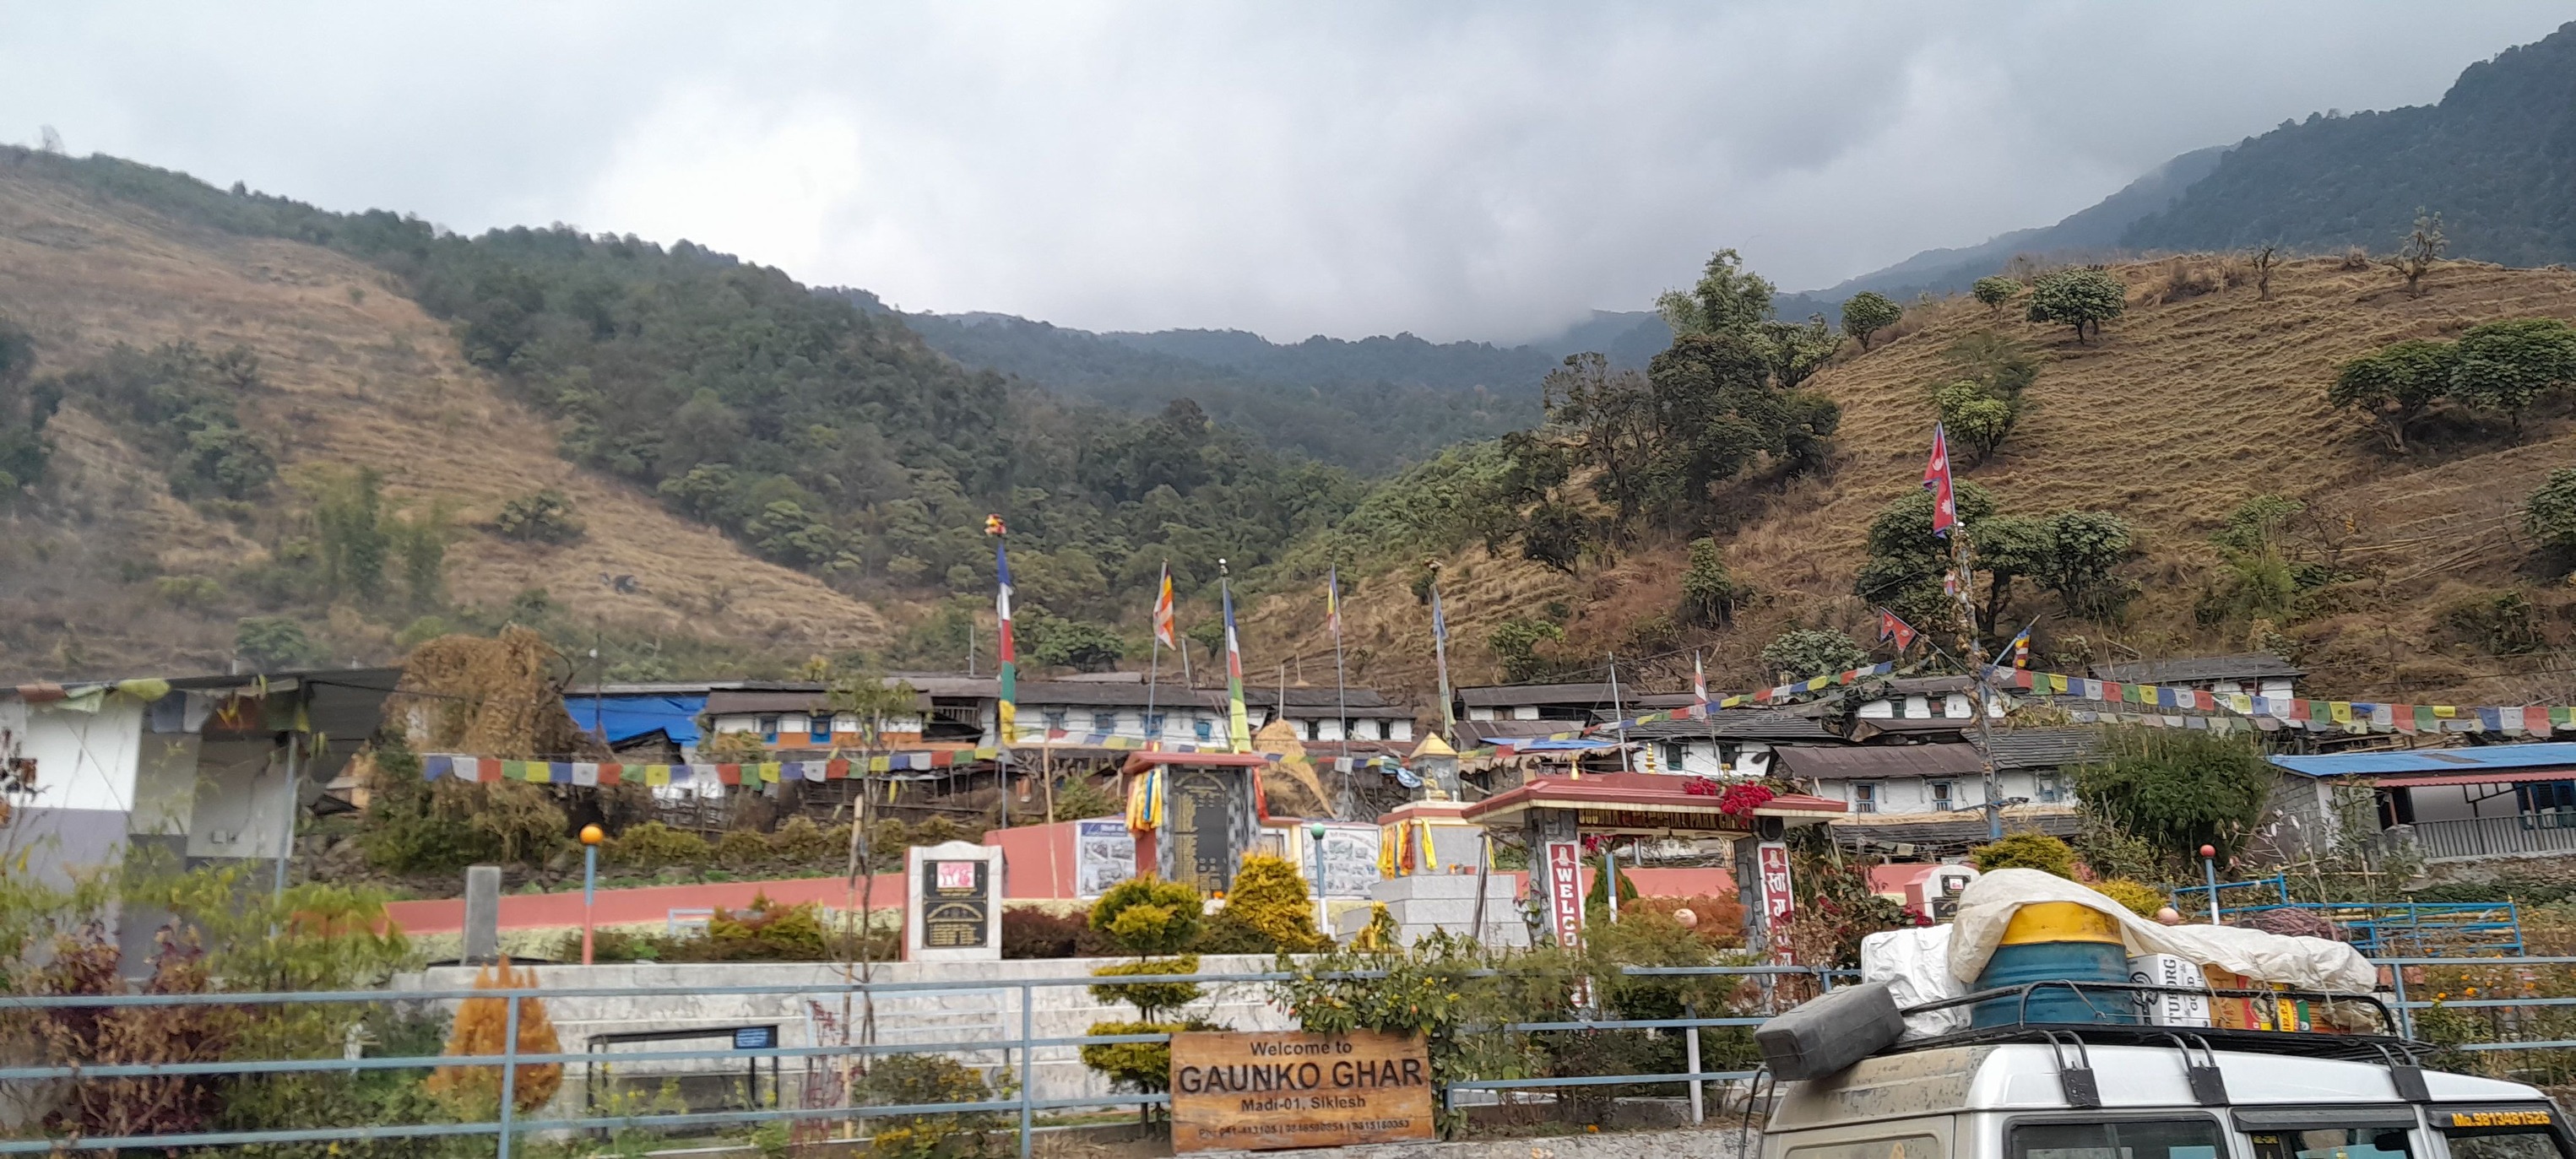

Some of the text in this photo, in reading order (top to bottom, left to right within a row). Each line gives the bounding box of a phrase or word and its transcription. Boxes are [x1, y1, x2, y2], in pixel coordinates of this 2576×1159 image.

[1556, 867, 1580, 963] WELCO
[1250, 1040, 1353, 1056] Welcome to
[1178, 1058, 1424, 1093] GAUNKO GHAR
[1241, 1096, 1366, 1113] Madi-01, Siklesh
[2451, 1110, 2552, 1127] Mo.9813481526
